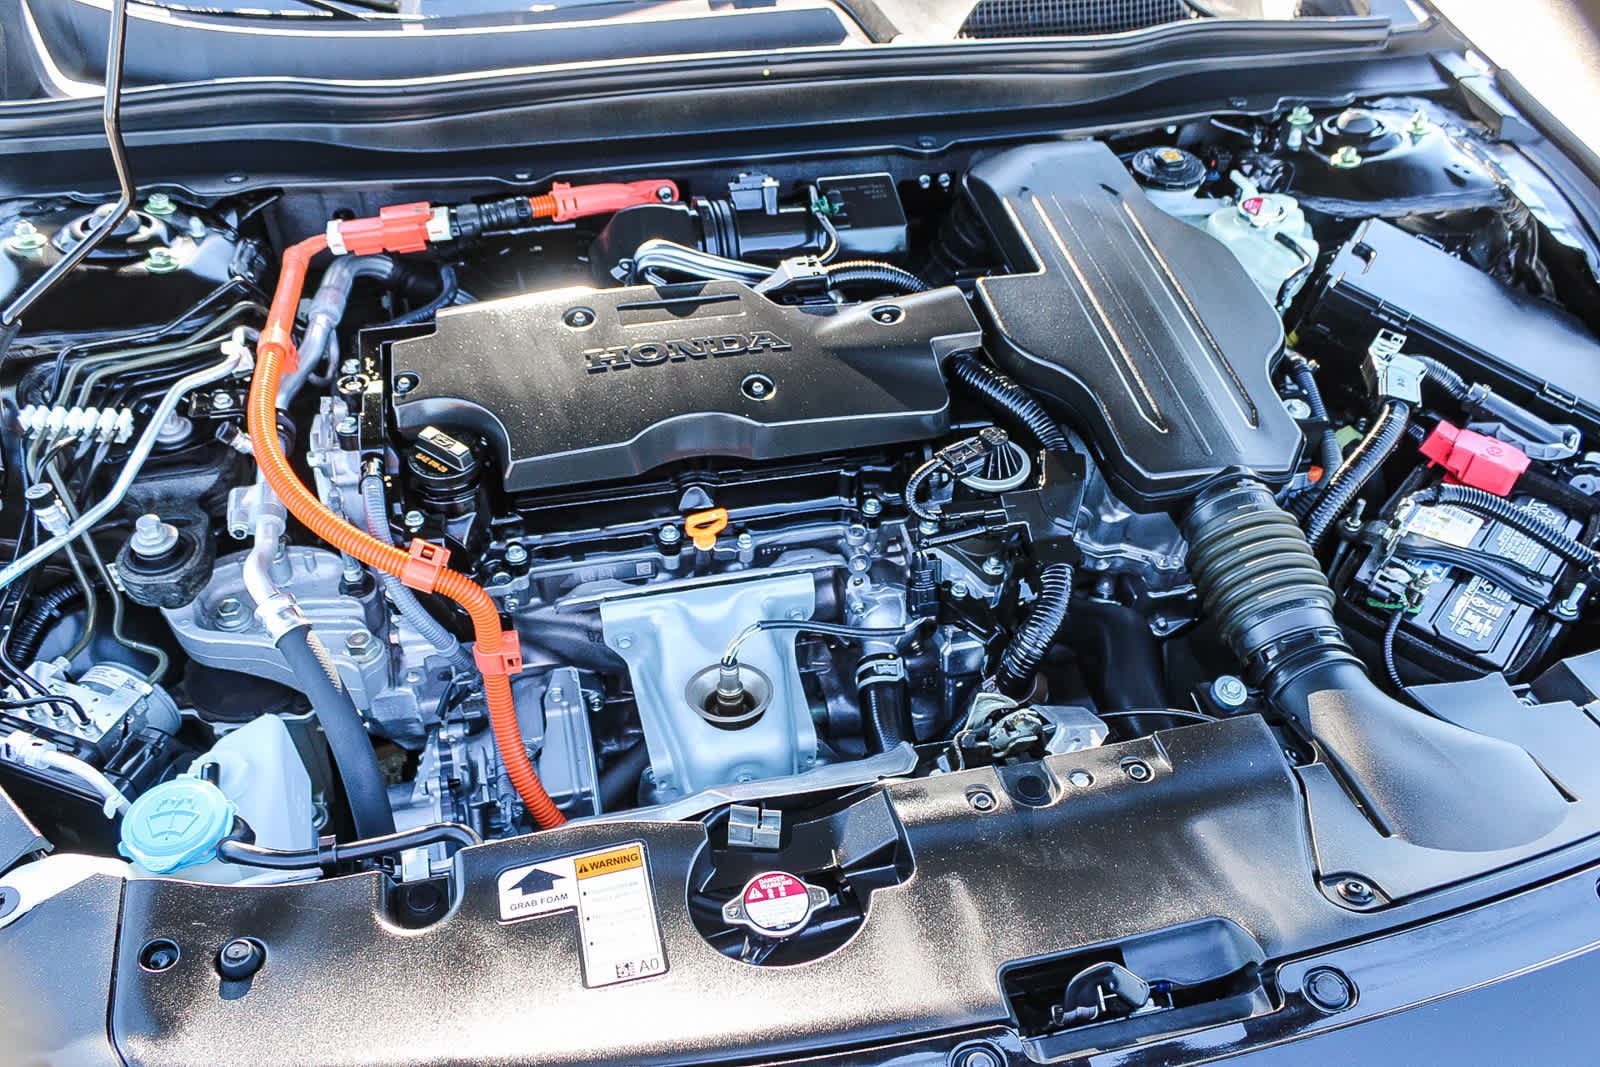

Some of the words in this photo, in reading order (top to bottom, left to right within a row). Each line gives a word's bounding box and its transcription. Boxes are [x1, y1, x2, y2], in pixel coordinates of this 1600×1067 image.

[584, 331, 792, 374] HONDA
[589, 853, 639, 871] WARNING
[510, 897, 538, 911] GRAB
[540, 893, 569, 905] FOAM
